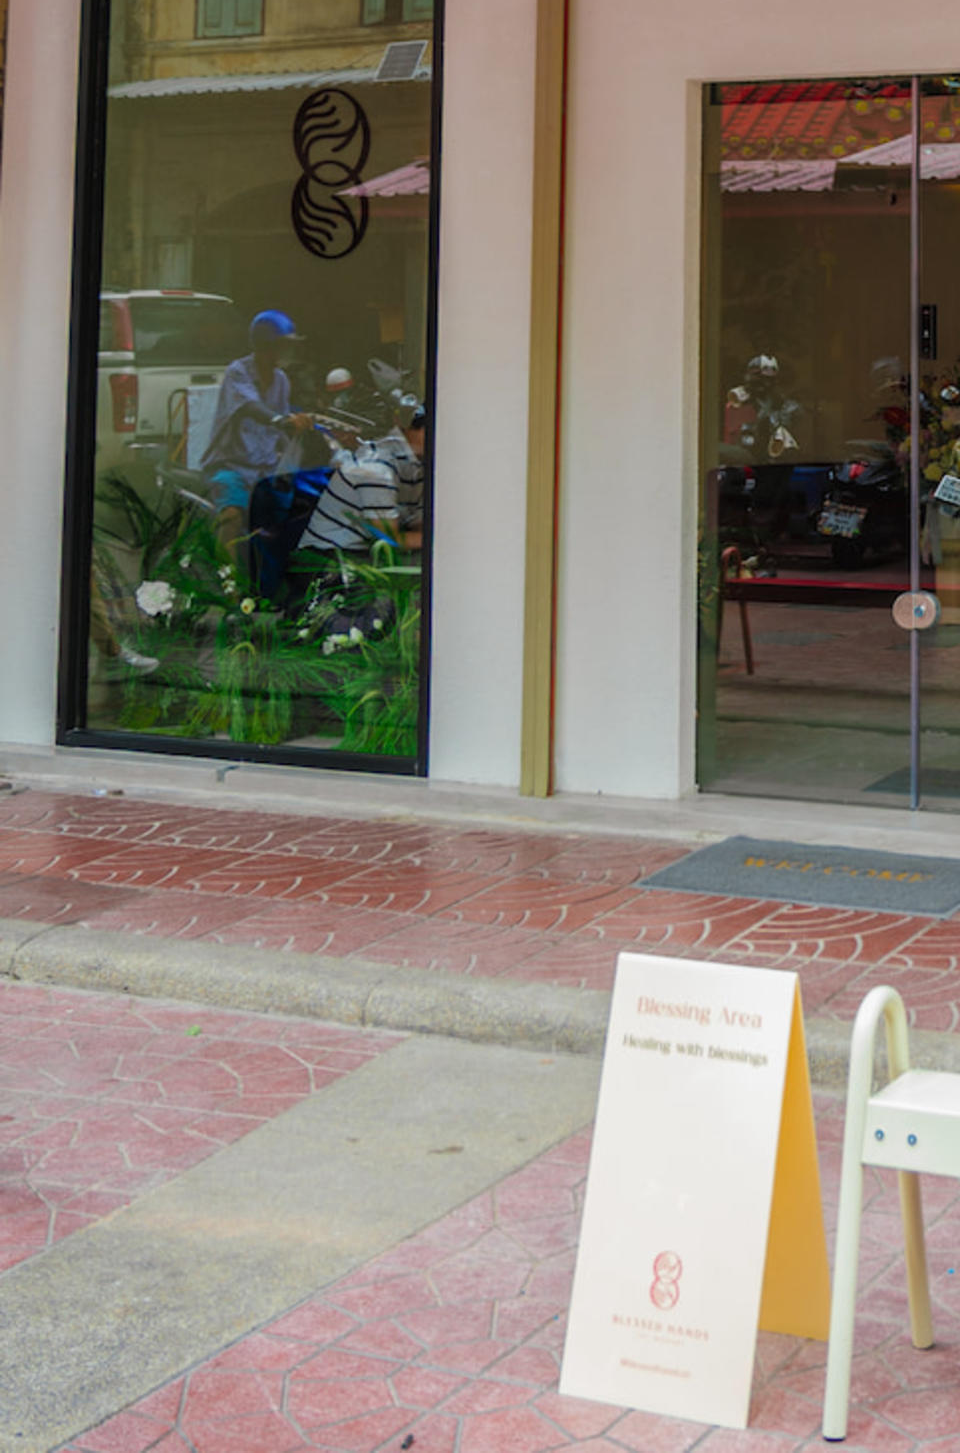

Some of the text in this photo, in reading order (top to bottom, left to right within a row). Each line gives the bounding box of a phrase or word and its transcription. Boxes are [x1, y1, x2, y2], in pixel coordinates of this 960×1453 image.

[637, 996, 763, 1028] Blessing Area
[622, 1033, 769, 1067] Healing with blessings
